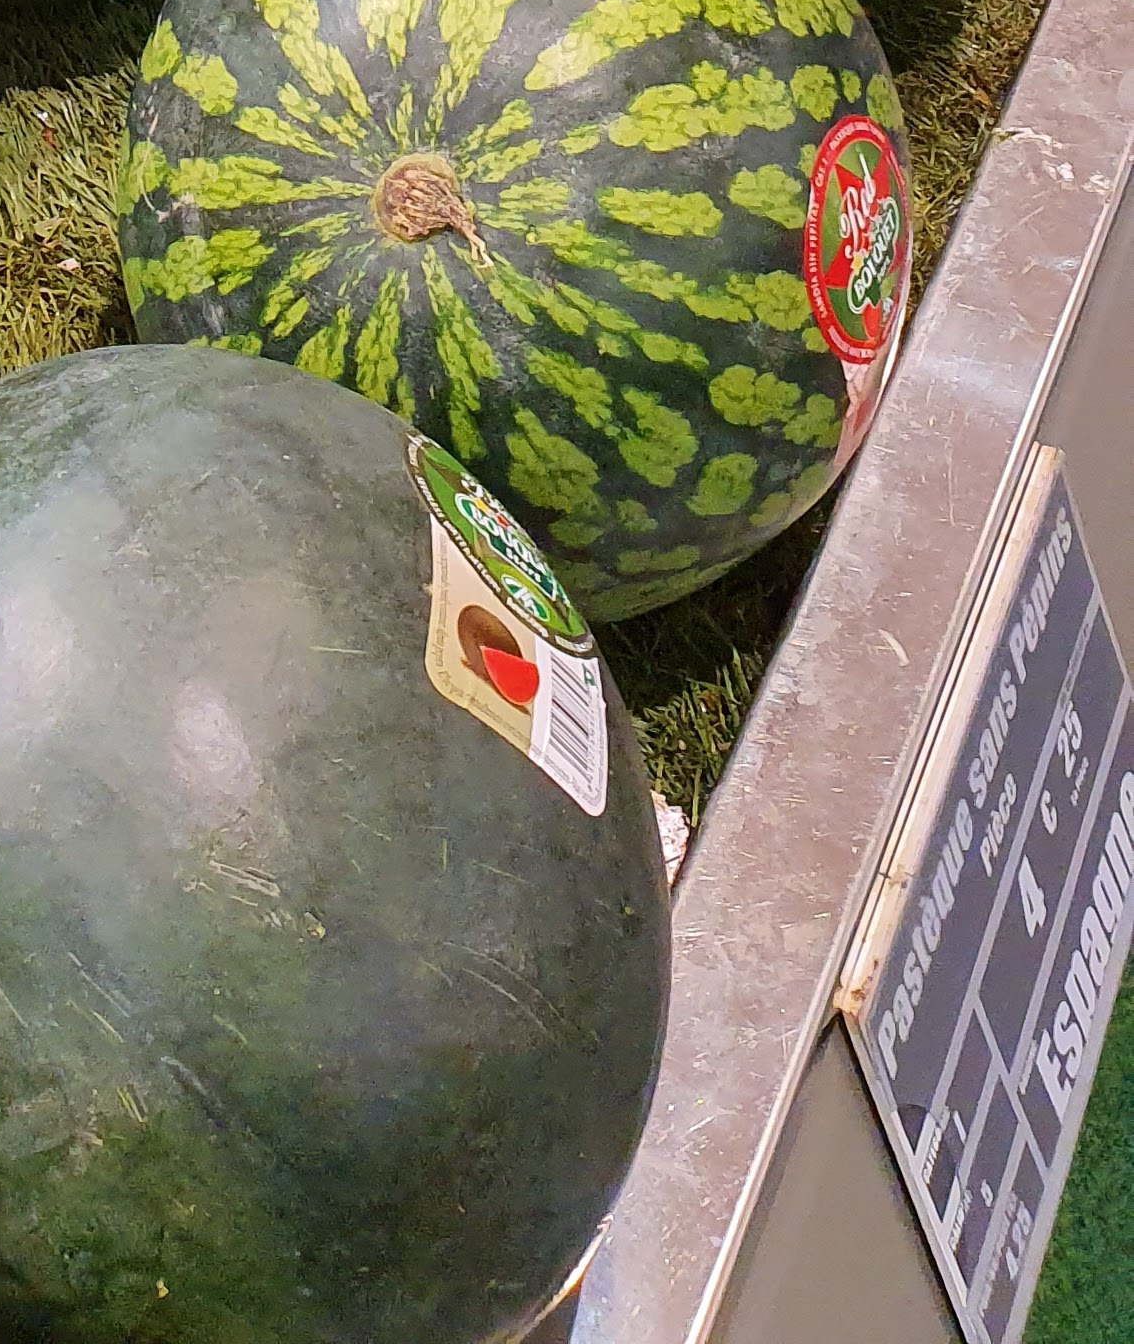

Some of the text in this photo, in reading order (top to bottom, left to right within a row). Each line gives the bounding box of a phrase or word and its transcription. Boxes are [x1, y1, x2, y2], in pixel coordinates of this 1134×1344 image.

[853, 208, 895, 303] BOUQUET
[878, 798, 974, 1081] Pastèque
[1009, 506, 1073, 685] Pépins
[979, 772, 1018, 878] Pièce
[1018, 854, 1047, 938] 4
[1057, 698, 1083, 779] 25
